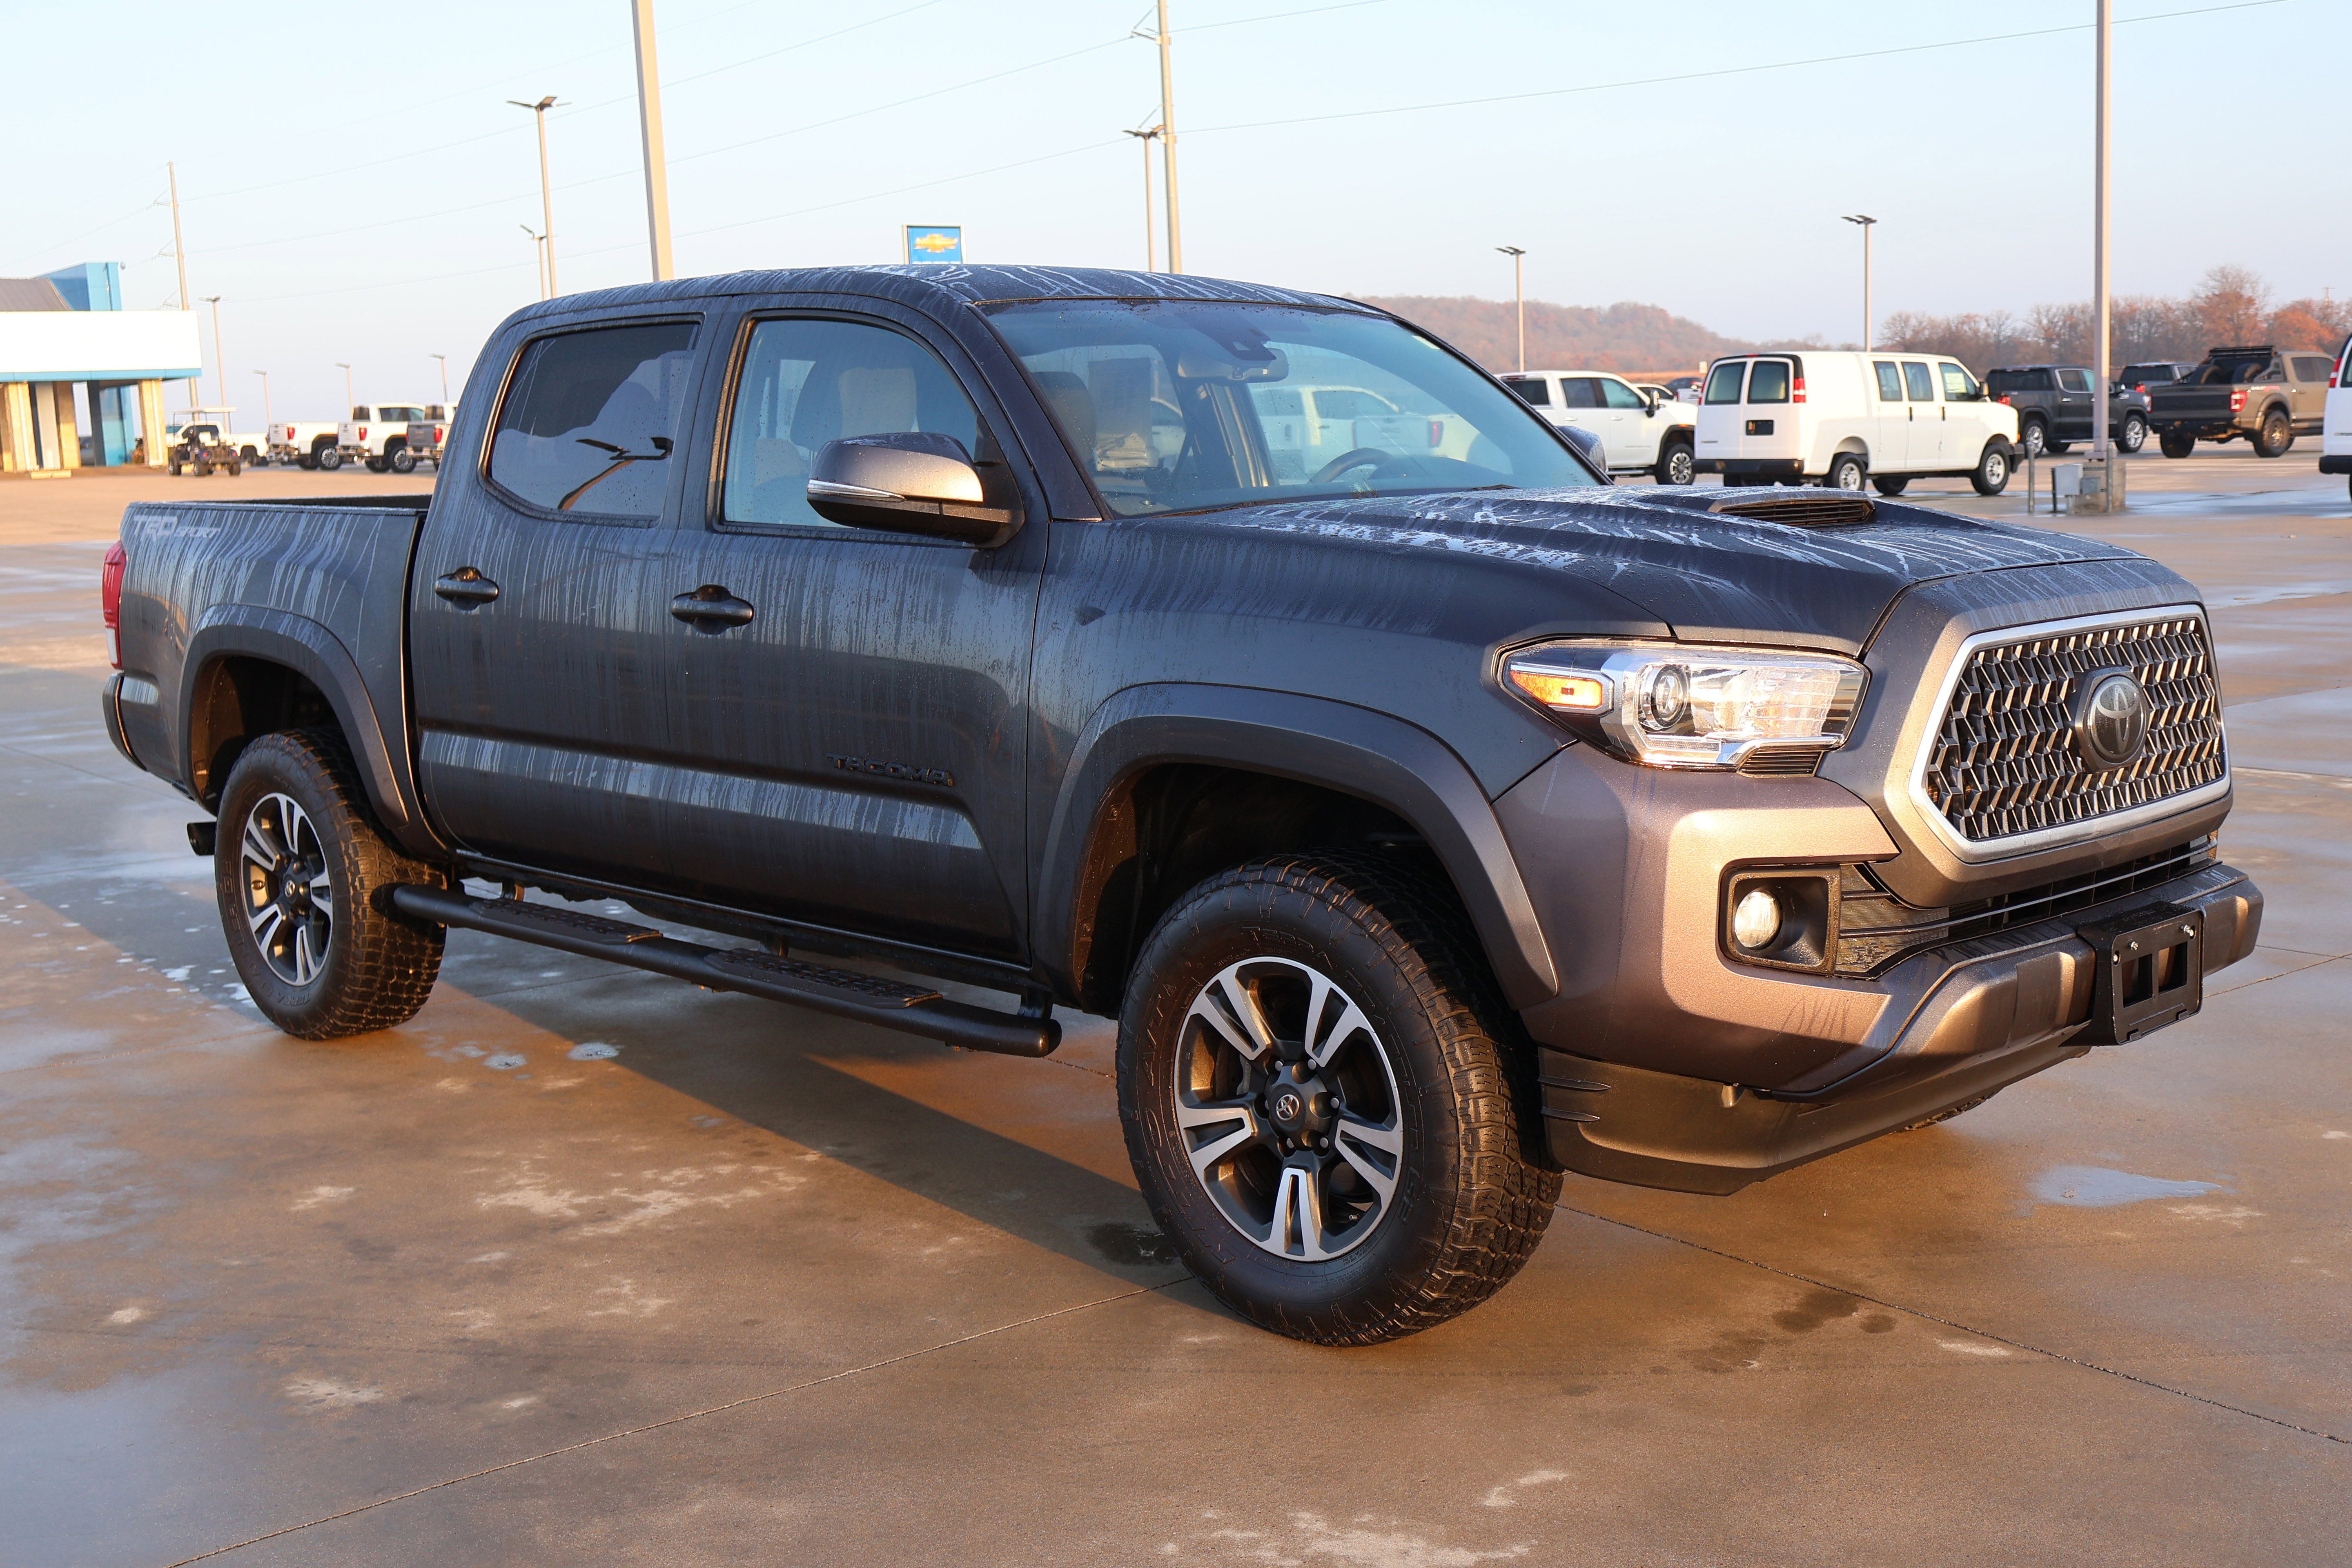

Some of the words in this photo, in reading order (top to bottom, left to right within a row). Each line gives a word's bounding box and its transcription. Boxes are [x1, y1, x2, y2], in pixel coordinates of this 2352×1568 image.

[133, 515, 178, 542] TRD
[174, 526, 221, 539] SPORT
[826, 752, 955, 787] TACOMA
[1241, 926, 1333, 970] TERRA
[1145, 1107, 1237, 1264] NITTO
